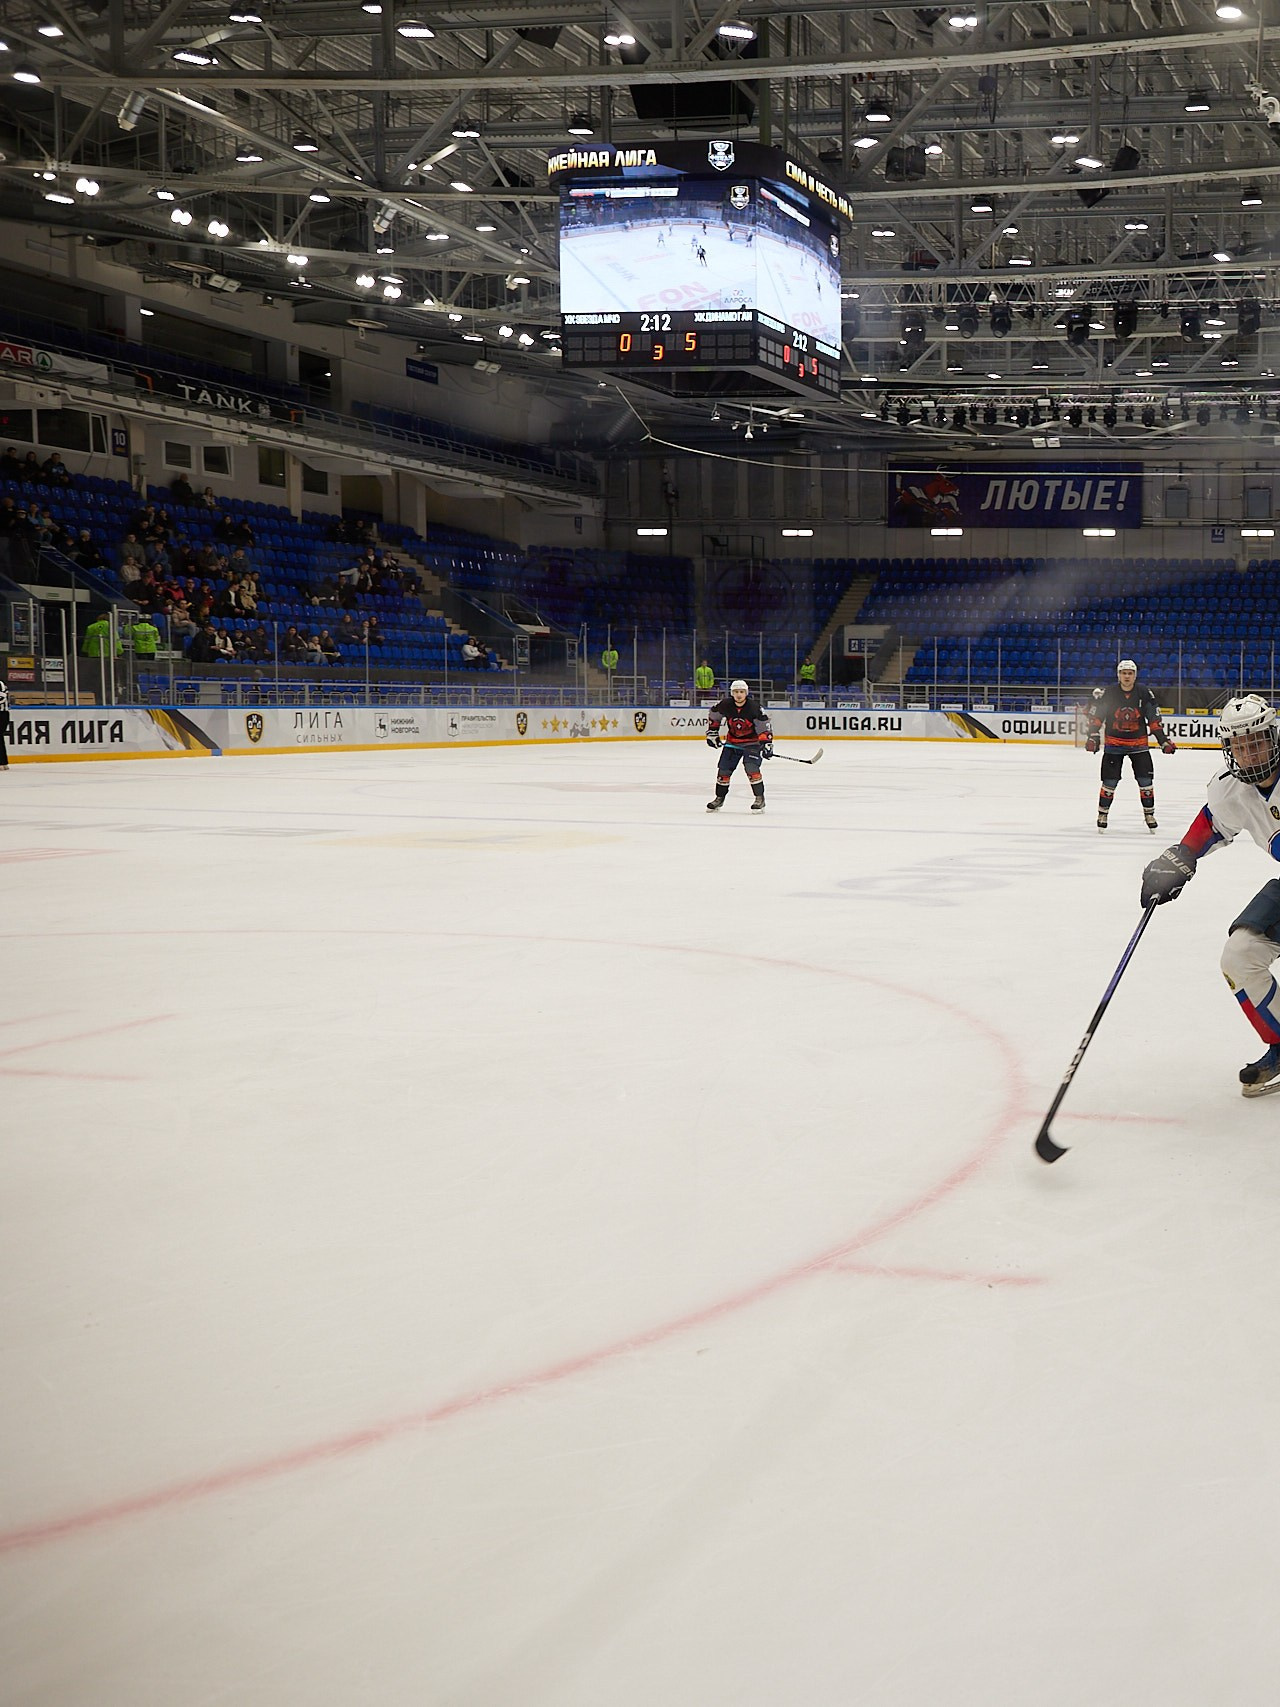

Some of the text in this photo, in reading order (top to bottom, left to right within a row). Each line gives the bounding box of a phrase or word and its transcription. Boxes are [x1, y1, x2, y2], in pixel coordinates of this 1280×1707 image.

[615, 150, 657, 166] ЛИГА
[640, 314, 672, 331] 2:12
[620, 334, 631, 351] 0
[685, 333, 696, 351] 5
[653, 345, 664, 360] 3
[177, 383, 253, 415] TANK
[113, 432, 126, 446] 10
[980, 480, 1129, 511] ЛЮТЫЕ!
[294, 712, 343, 729] ЛИГА
[806, 717, 902, 731] OHLIGA.RU
[62, 720, 123, 744] ЛИГА
[296, 734, 343, 743] СИЛЬНЫХ
